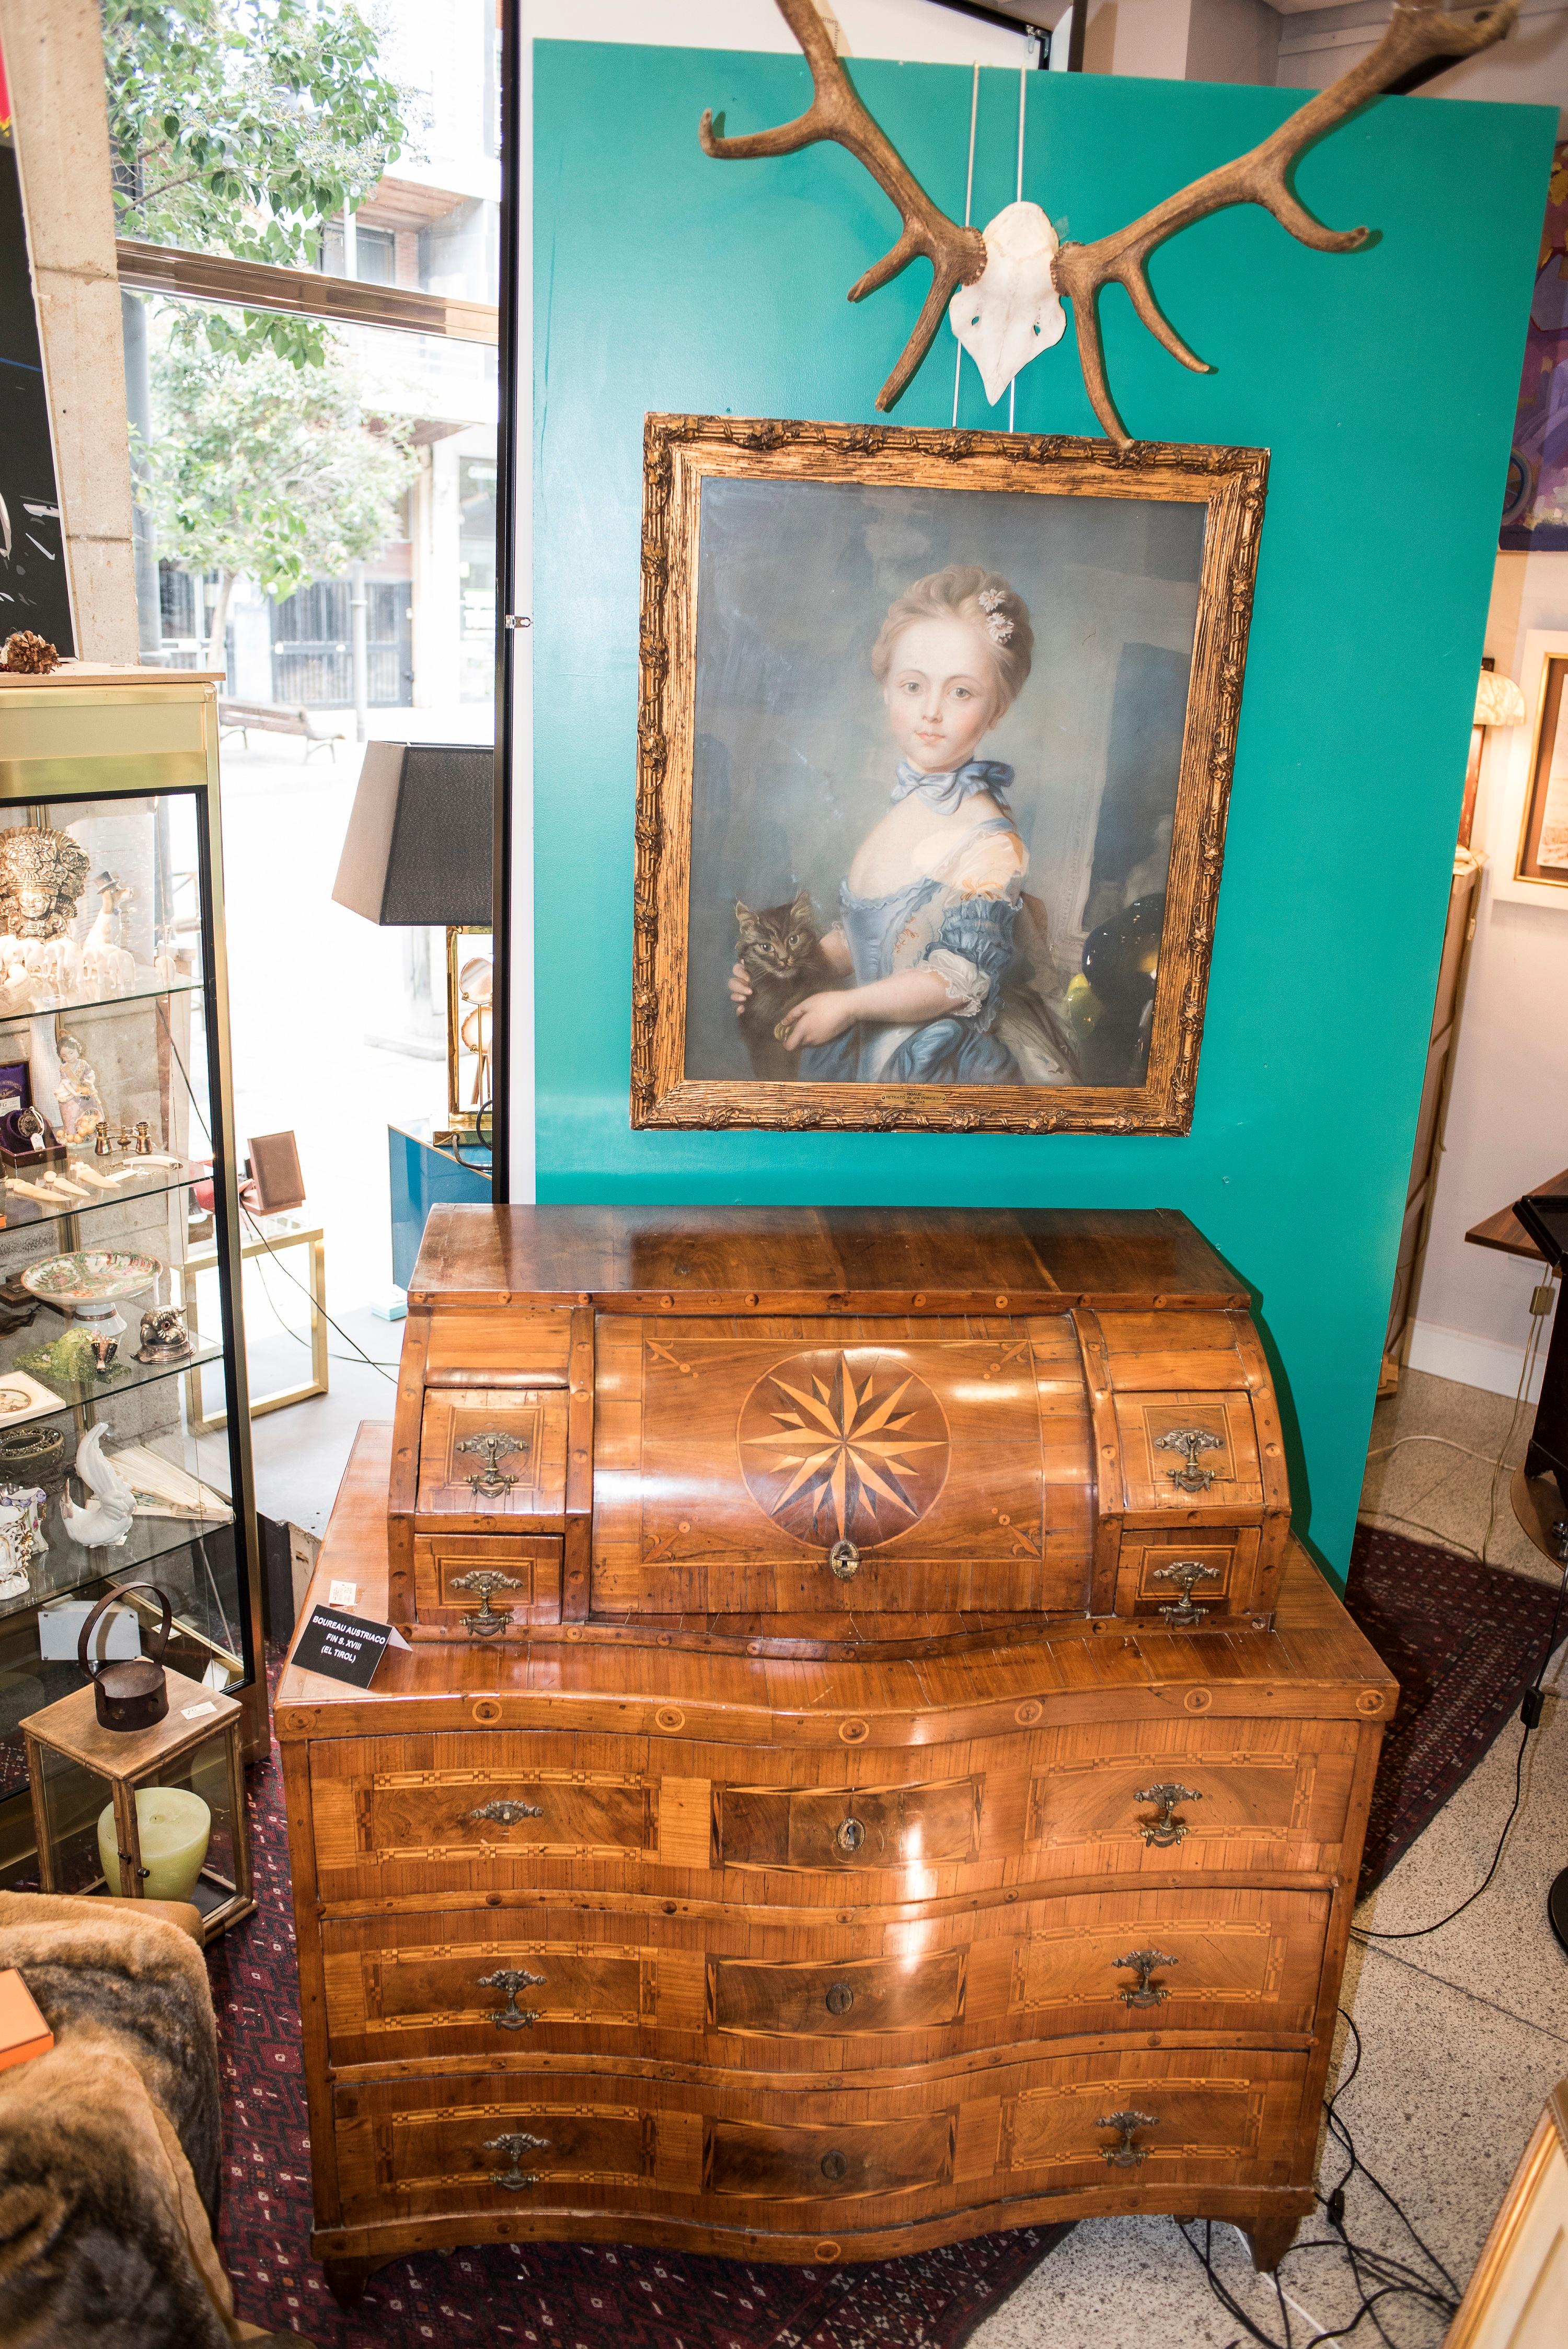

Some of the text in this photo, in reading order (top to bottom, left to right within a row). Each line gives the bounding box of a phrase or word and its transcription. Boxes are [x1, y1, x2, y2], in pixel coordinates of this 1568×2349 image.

[312, 1615, 386, 1644] BOUREAU AUSTRIACO
[326, 1633, 362, 1651] FIN S. XVIII
[321, 1645, 356, 1664] (EL TIROL)
